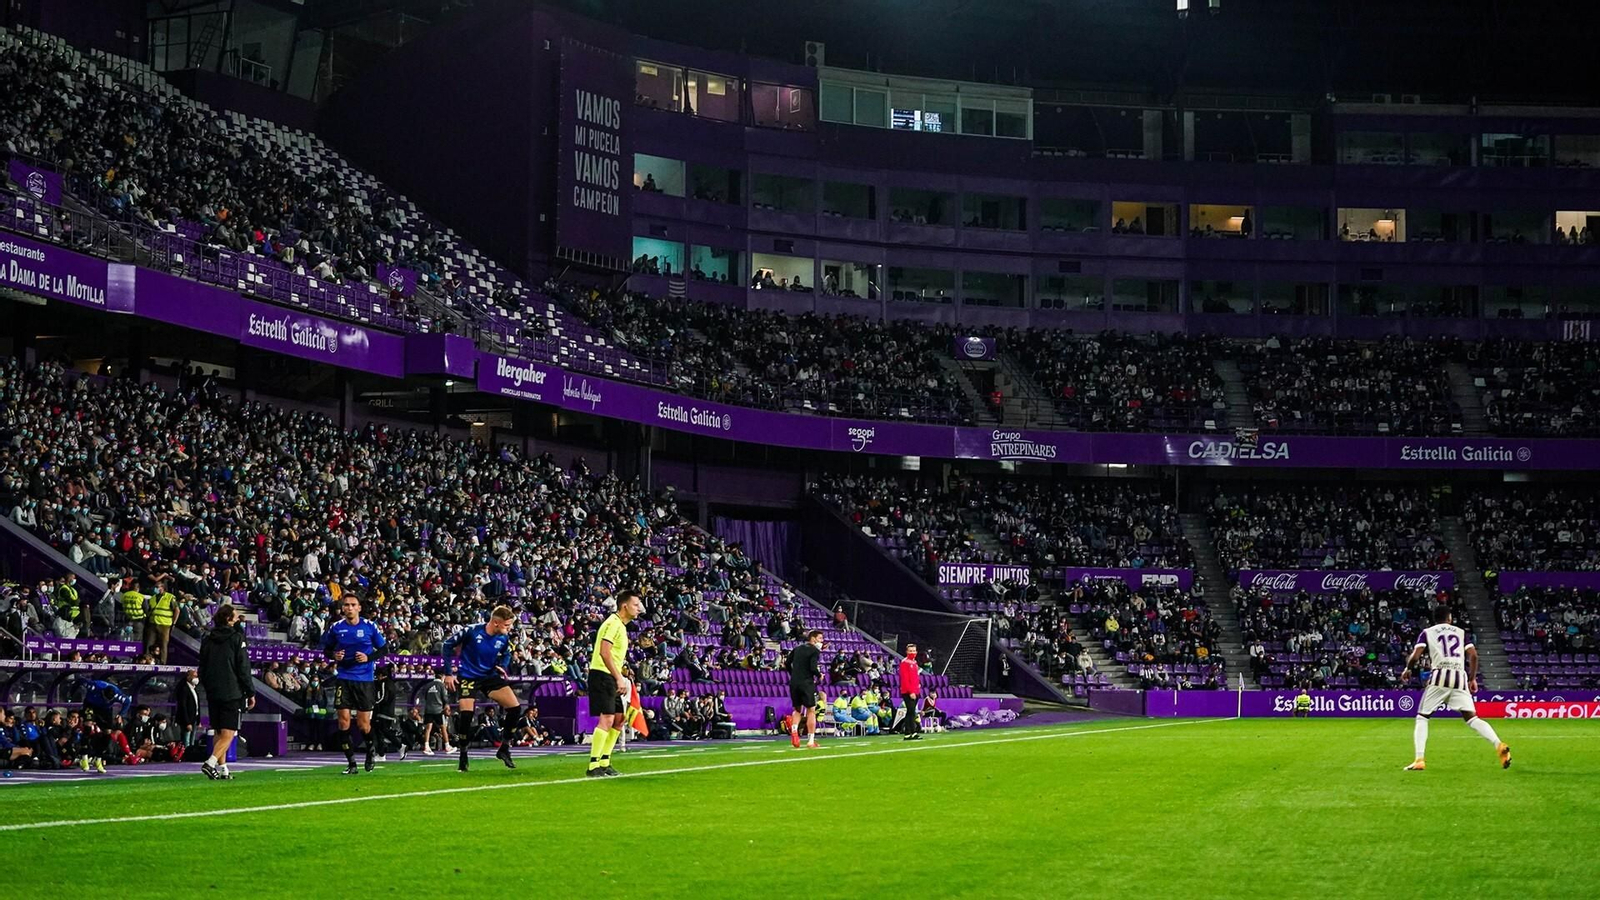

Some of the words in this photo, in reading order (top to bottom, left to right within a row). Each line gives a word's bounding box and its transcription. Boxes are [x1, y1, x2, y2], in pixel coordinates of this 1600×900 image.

[576, 89, 620, 130] VAMOS
[575, 125, 586, 146] MI
[589, 128, 620, 155] PUCELA
[575, 150, 619, 190] VAMOS
[574, 185, 619, 216] CAMPEÓN
[0, 241, 45, 262] estaurante
[0, 263, 7, 280] A
[248, 313, 290, 341] Estrella
[291, 322, 326, 351] Galicia
[497, 357, 546, 387] Hergaher
[657, 401, 689, 423] Estrella
[690, 407, 721, 428] Galicia
[848, 426, 875, 452] segopi
[992, 429, 1021, 442] Grupo
[990, 443, 1057, 458] ENTREPINARES
[1400, 445, 1457, 461] Estrella
[1461, 446, 1513, 461] Galicia
[939, 566, 986, 584] SIEMPRE
[989, 567, 1030, 586] JUNTOS
[1437, 634, 1460, 658] 12
[1273, 695, 1336, 712] Estella
[1338, 695, 1395, 712] Galicia
